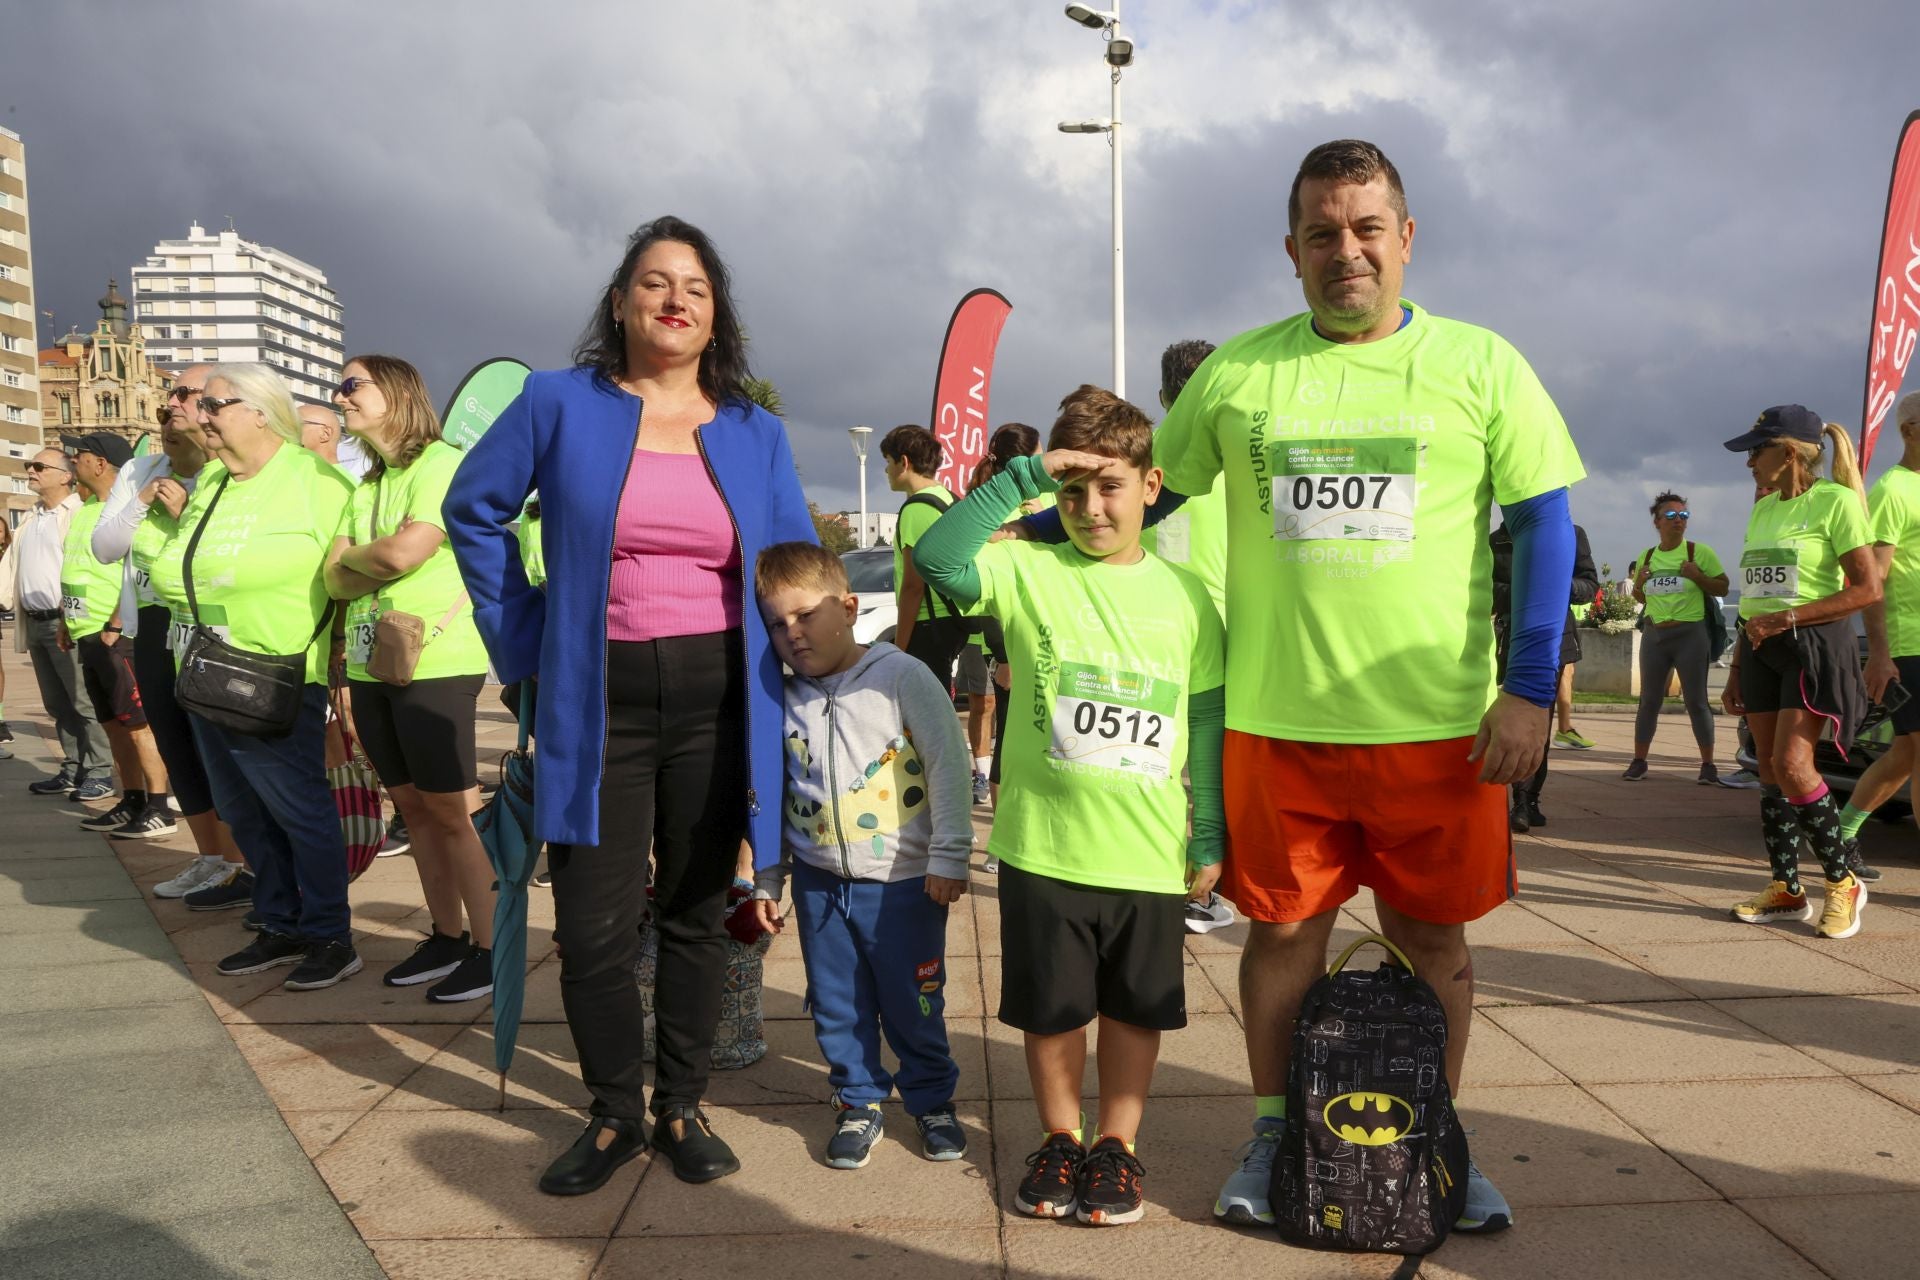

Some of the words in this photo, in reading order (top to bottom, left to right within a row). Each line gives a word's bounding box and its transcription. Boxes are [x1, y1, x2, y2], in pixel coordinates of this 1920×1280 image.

[1274, 415, 1310, 436] En
[1318, 410, 1437, 435] marcha
[1288, 447, 1310, 457] Gijón
[1288, 456, 1314, 464] contra
[1250, 410, 1270, 515] ASTURIAS
[1292, 475, 1392, 511] 0507
[1274, 545, 1368, 564] LABORAL
[1326, 563, 1369, 579] kutxa
[1745, 566, 1787, 585] 0585
[1652, 577, 1677, 588] 1454
[1032, 623, 1053, 734] ASTURIAS
[1075, 680, 1101, 690] contra
[1073, 701, 1162, 748] 0512
